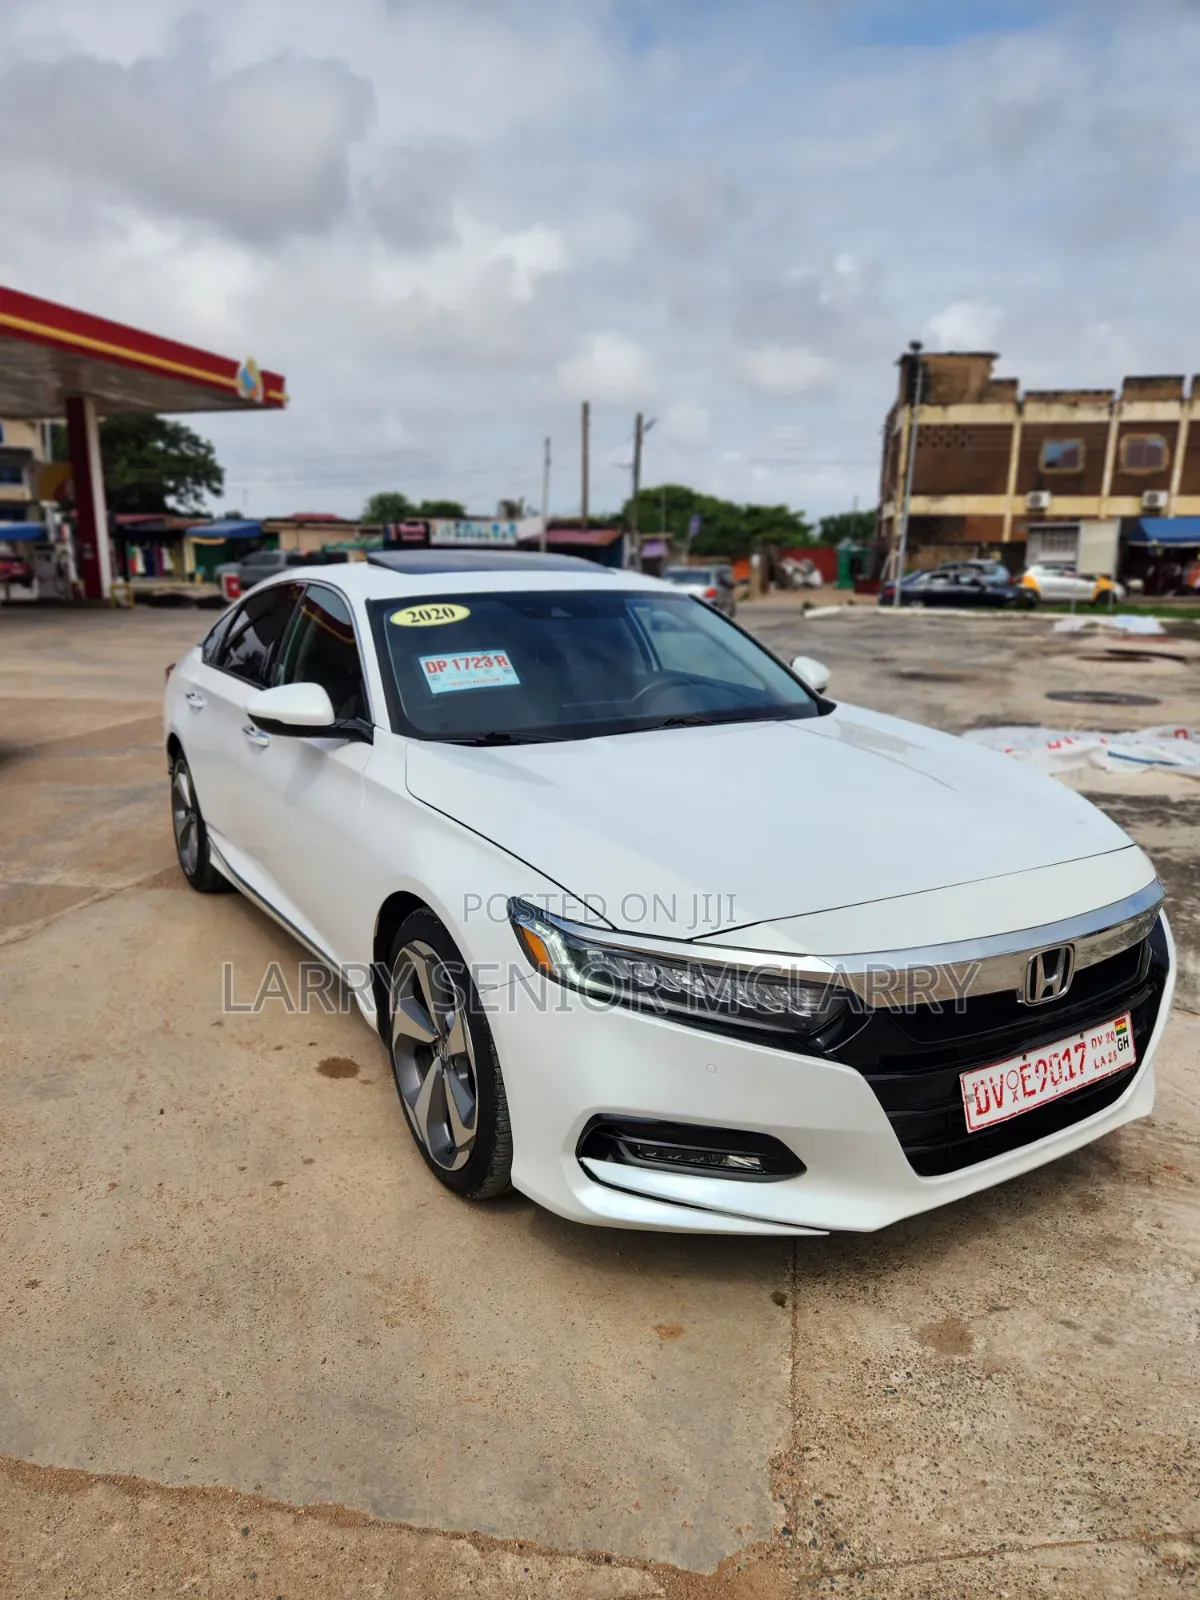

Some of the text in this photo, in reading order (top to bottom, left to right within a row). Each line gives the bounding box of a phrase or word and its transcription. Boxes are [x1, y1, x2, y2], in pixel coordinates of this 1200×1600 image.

[406, 607, 456, 623] 2020
[425, 660, 448, 674] DP
[452, 655, 494, 671] 1723
[1117, 1035, 1129, 1052] GH
[972, 1074, 1004, 1116] DV
